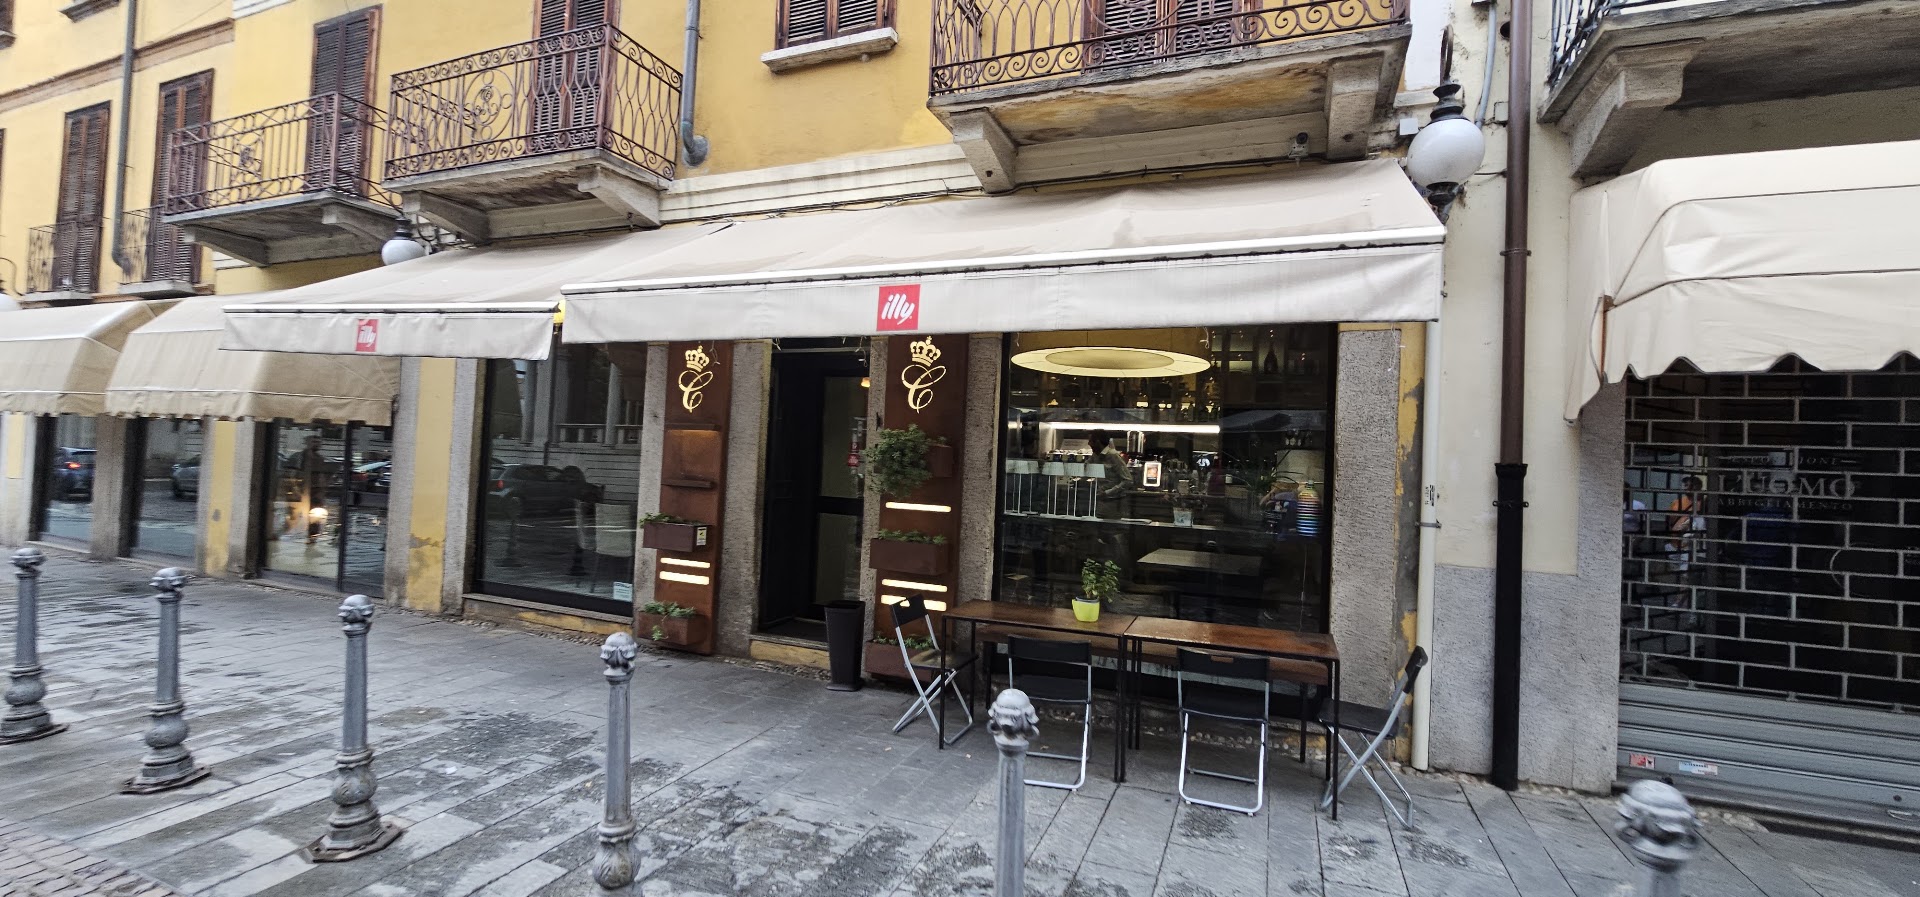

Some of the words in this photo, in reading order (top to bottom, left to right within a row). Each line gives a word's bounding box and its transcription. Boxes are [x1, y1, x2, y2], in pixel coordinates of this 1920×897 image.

[881, 293, 916, 326] illy
[357, 325, 377, 348] illy
[1730, 455, 1838, 466] ESPOIONE
